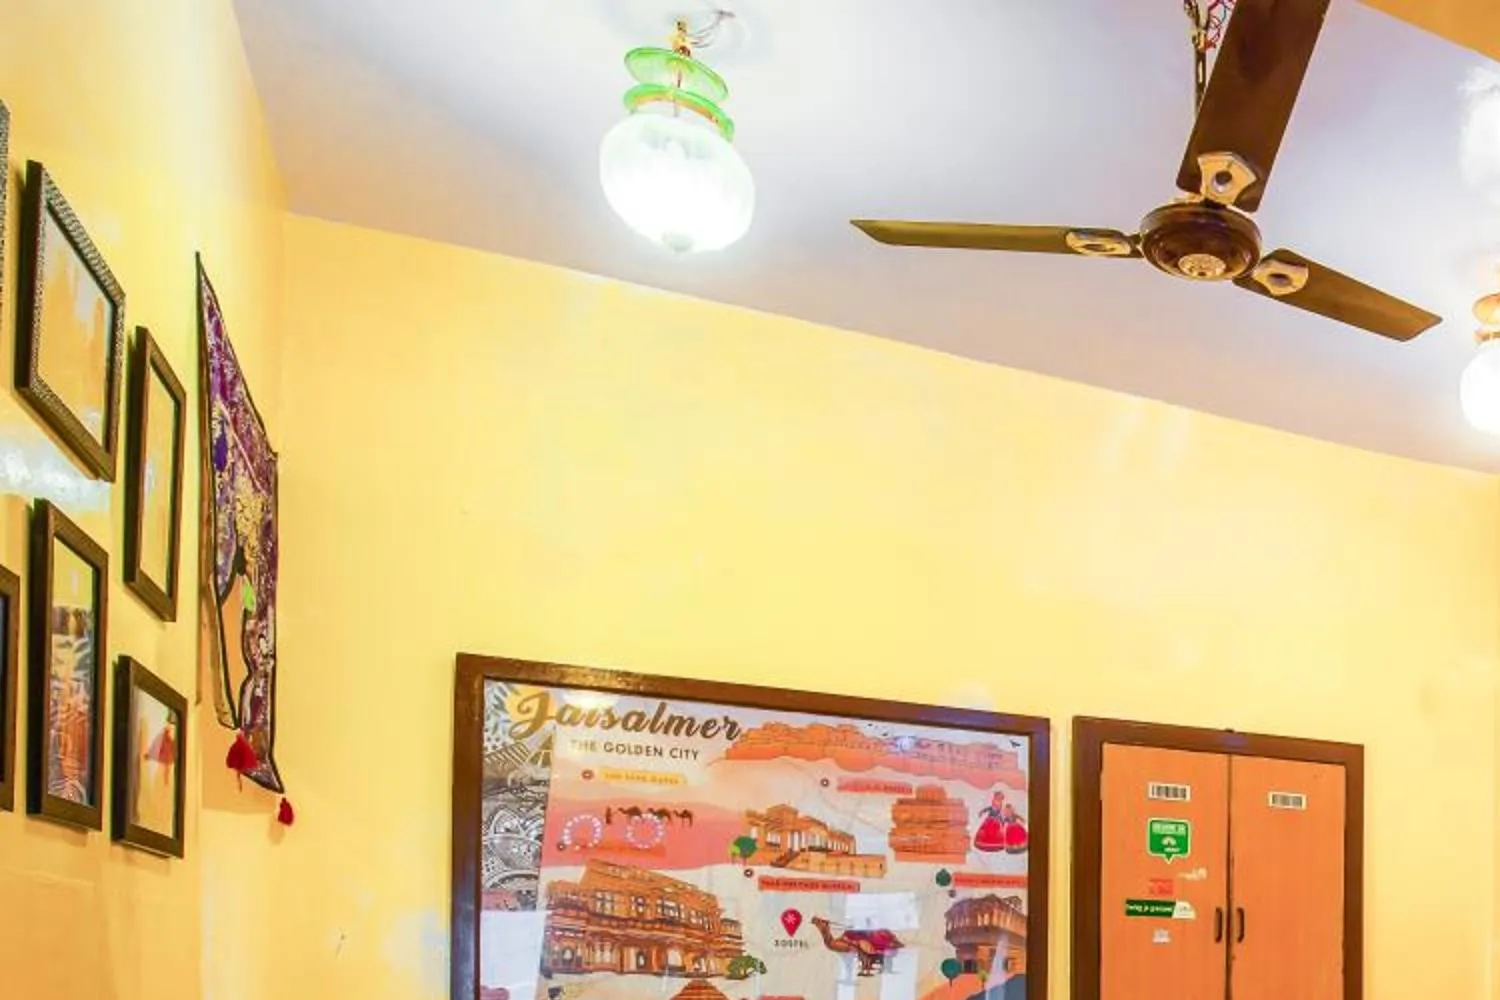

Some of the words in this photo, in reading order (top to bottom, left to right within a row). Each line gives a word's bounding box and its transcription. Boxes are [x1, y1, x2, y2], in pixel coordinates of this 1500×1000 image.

[509, 691, 743, 741] Jaisalmer
[603, 742, 664, 758] GOLDEN
[669, 746, 700, 761] CITY
